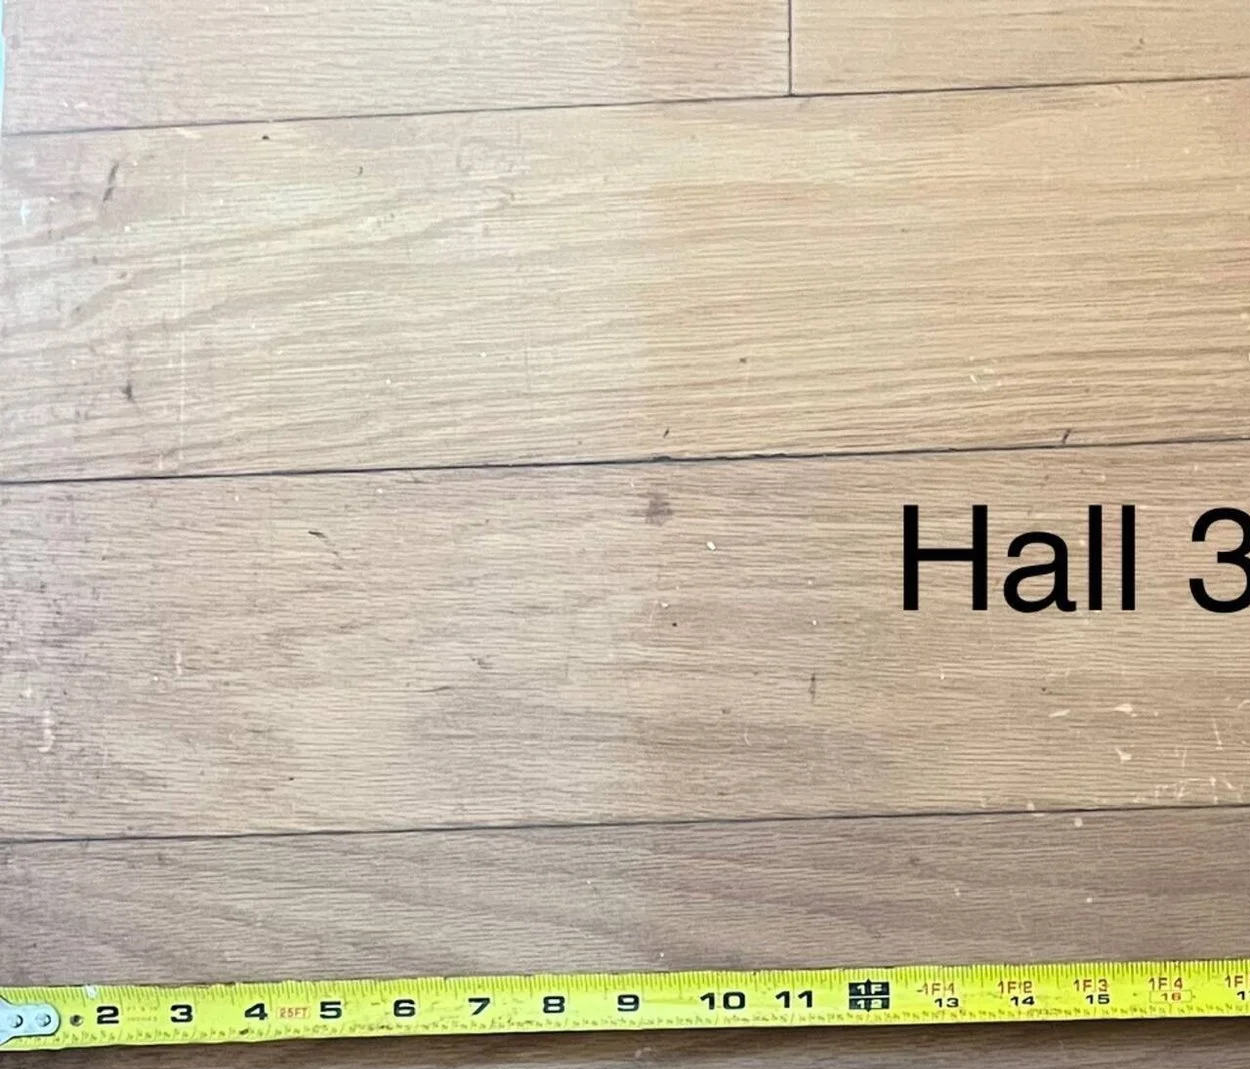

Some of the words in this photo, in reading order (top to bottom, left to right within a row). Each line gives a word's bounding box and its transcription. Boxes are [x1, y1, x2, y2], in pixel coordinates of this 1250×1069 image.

[856, 984, 882, 994] 1F
[1161, 993, 1181, 1001] 16
[393, 999, 415, 1017] 6
[468, 998, 490, 1015] 7
[543, 996, 565, 1014] 8
[617, 994, 639, 1012] 9
[700, 992, 746, 1010] 10
[775, 990, 813, 1008] 11
[856, 1000, 882, 1009] 12
[934, 998, 959, 1008] 13
[1010, 996, 1035, 1006] 14
[1085, 994, 1110, 1004] 15
[96, 1005, 119, 1024] 2
[170, 1004, 193, 1023] 3
[244, 1002, 268, 1021] 4
[279, 1008, 308, 1018] 25FT
[319, 1001, 343, 1019] 5
